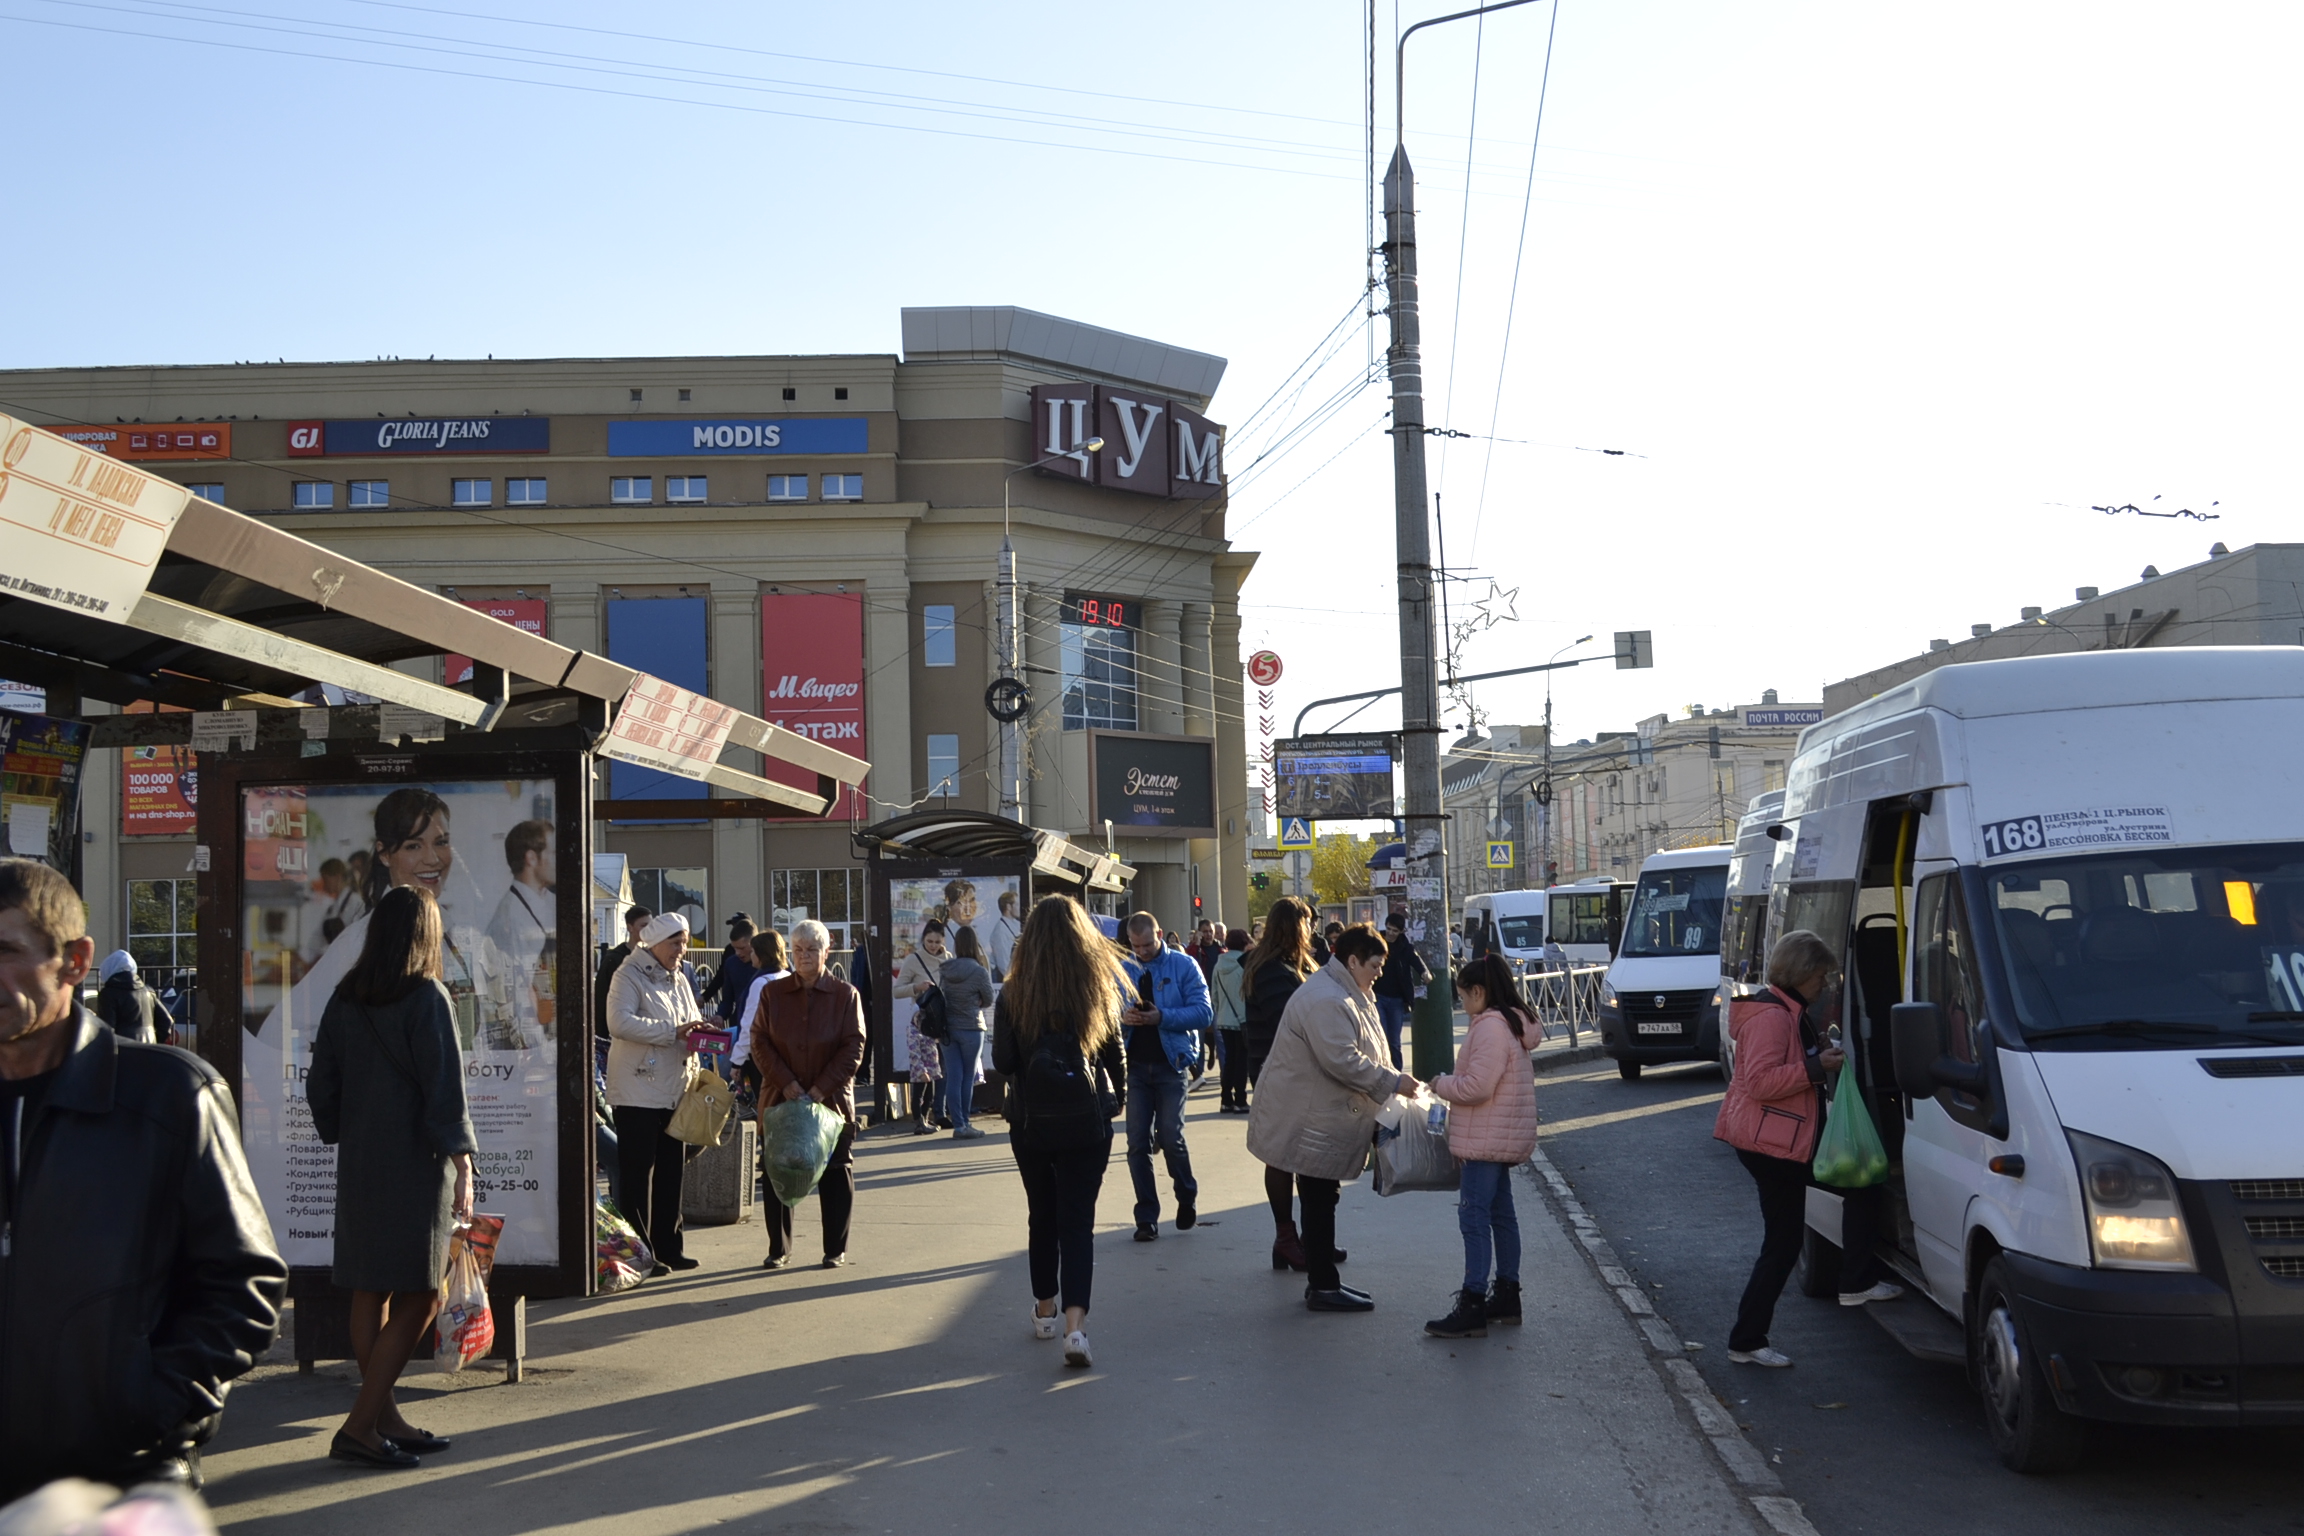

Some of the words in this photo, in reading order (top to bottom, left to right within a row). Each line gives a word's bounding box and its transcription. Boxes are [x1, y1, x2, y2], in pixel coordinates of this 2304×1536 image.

[291, 428, 319, 449] GJ
[693, 425, 781, 448] MODIS
[1045, 396, 1222, 485] ЦУМ
[490, 609, 515, 617] GOLD
[769, 675, 859, 702] М.видео
[1748, 713, 1780, 724] ПОЧТА
[1784, 712, 1820, 722] РОССИИ
[794, 722, 859, 739] этаж
[1303, 739, 1357, 749] ЦЕНТРАЛЬНЫЙ
[1357, 740, 1384, 748] РЫНОК
[367, 765, 406, 773] 20-97-91
[1124, 767, 1181, 796] Эстет
[129, 786, 168, 795] ТОВАРОВ
[148, 809, 196, 820] dns-shop.ru
[2104, 807, 2166, 818] Ц.РЫНОК
[2046, 818, 2109, 831] ул.Суворова
[1984, 819, 2042, 854] 168
[2048, 832, 2122, 847] БЕССОНОВКА
[2124, 831, 2171, 842] БЕСКОМ
[1516, 936, 1526, 946] 85
[1684, 926, 1702, 949] 89
[290, 1107, 313, 1118] Про
[290, 1145, 335, 1155] Поваров
[515, 1150, 533, 1160] 221
[290, 1157, 334, 1168] Пекарей
[288, 1228, 330, 1239] Новый
